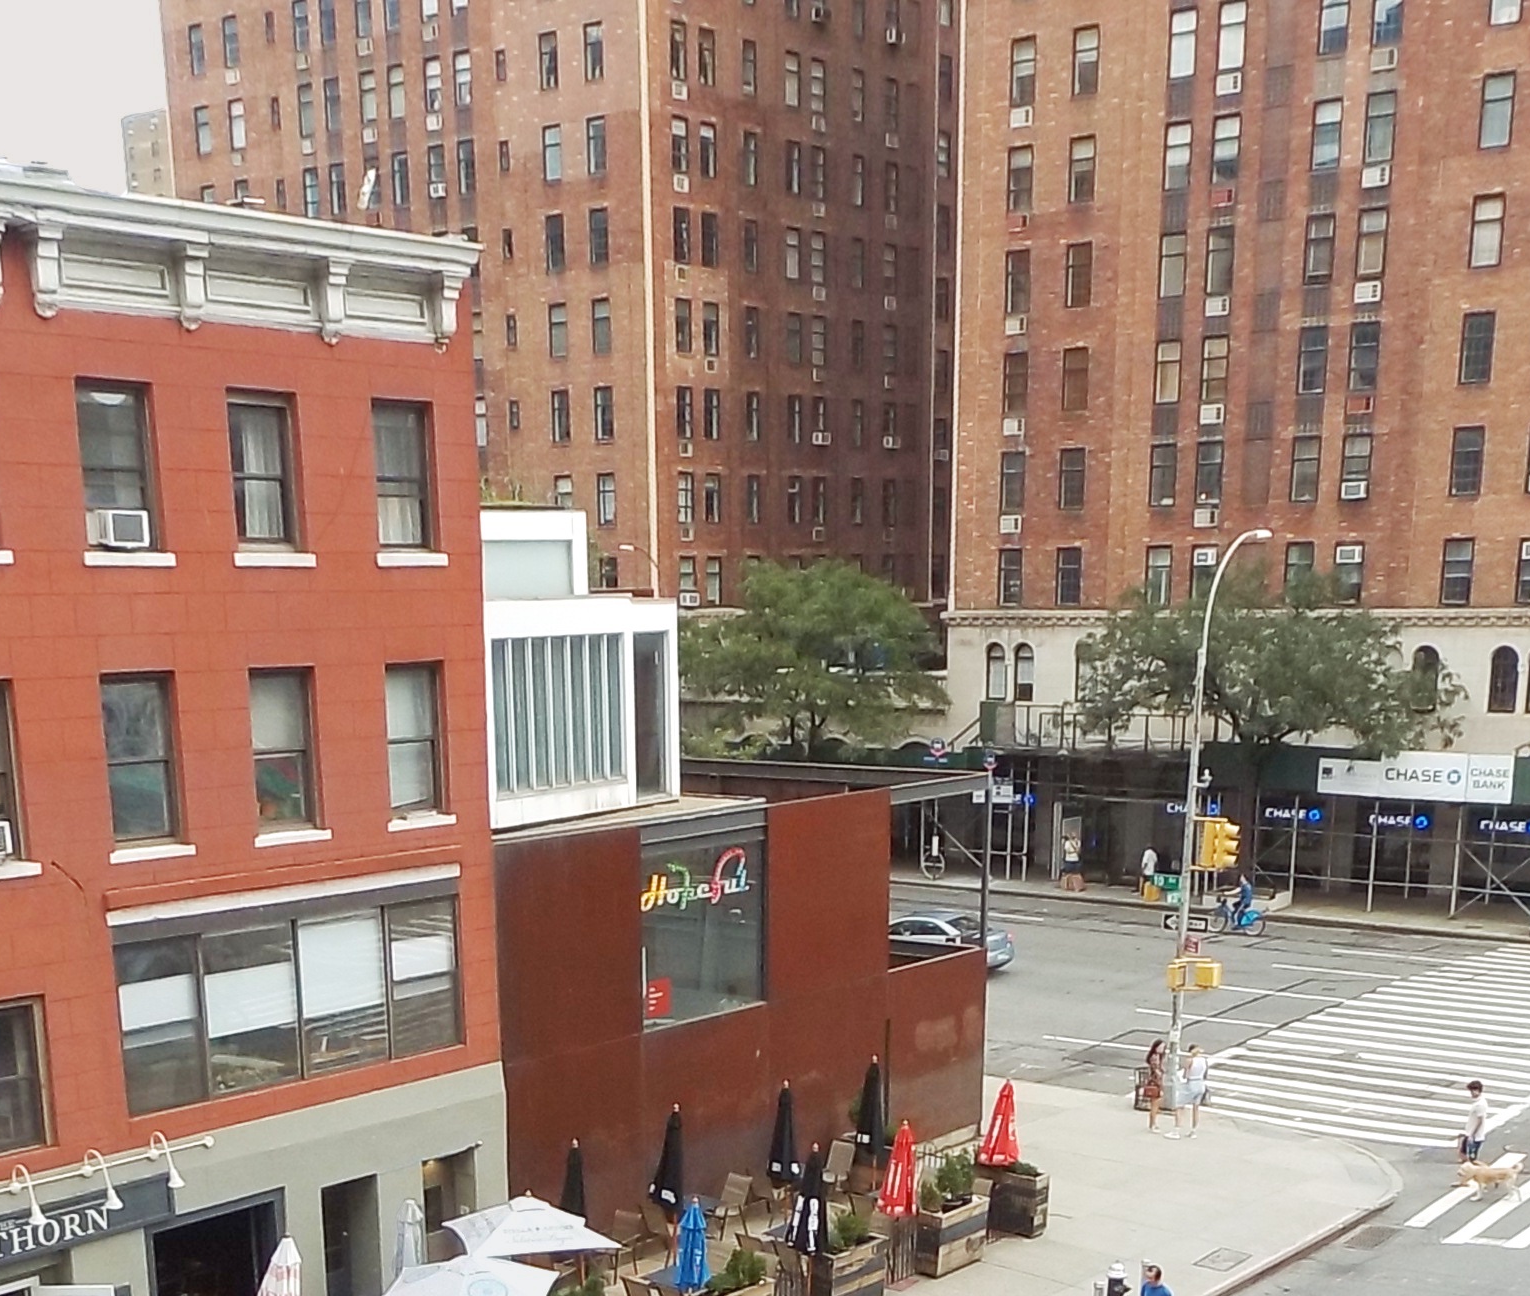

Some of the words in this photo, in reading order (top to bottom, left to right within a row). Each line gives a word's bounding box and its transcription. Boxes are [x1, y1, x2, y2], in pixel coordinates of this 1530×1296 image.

[1385, 767, 1443, 783] CHASE
[1470, 768, 1509, 779] CHASE
[1472, 779, 1506, 791] BANK
[640, 847, 750, 912] Hopeful
